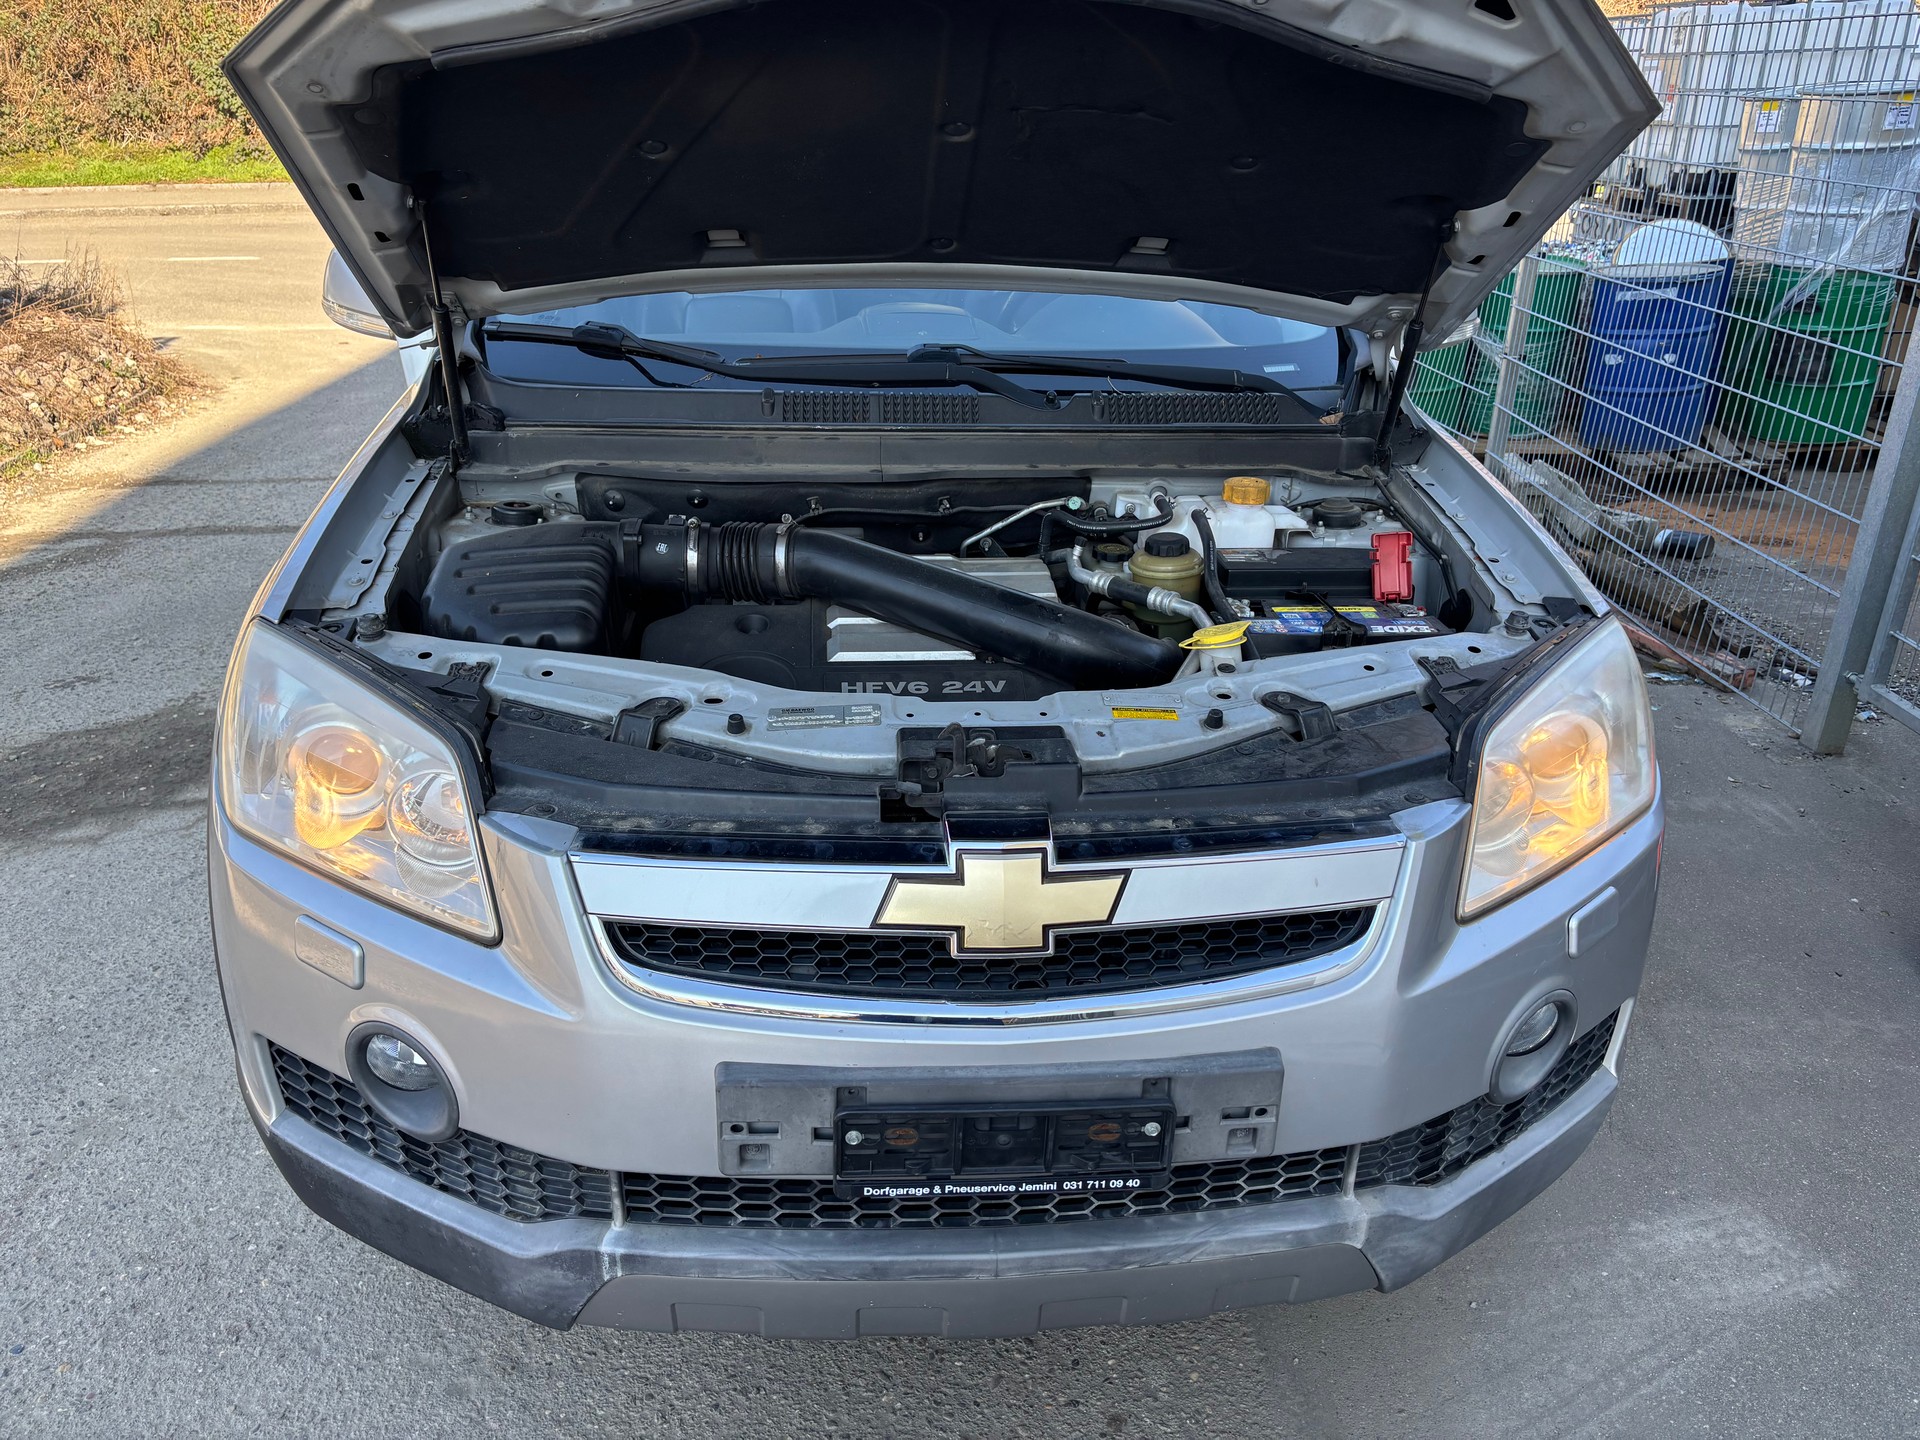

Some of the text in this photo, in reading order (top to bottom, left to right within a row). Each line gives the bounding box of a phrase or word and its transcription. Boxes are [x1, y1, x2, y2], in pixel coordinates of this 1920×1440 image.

[1370, 625, 1432, 633] EXIDE
[941, 680, 1007, 694] 24V
[863, 1178, 1140, 1197] Dorfgarage & Pneuservice Jemini 031 711 09 40
